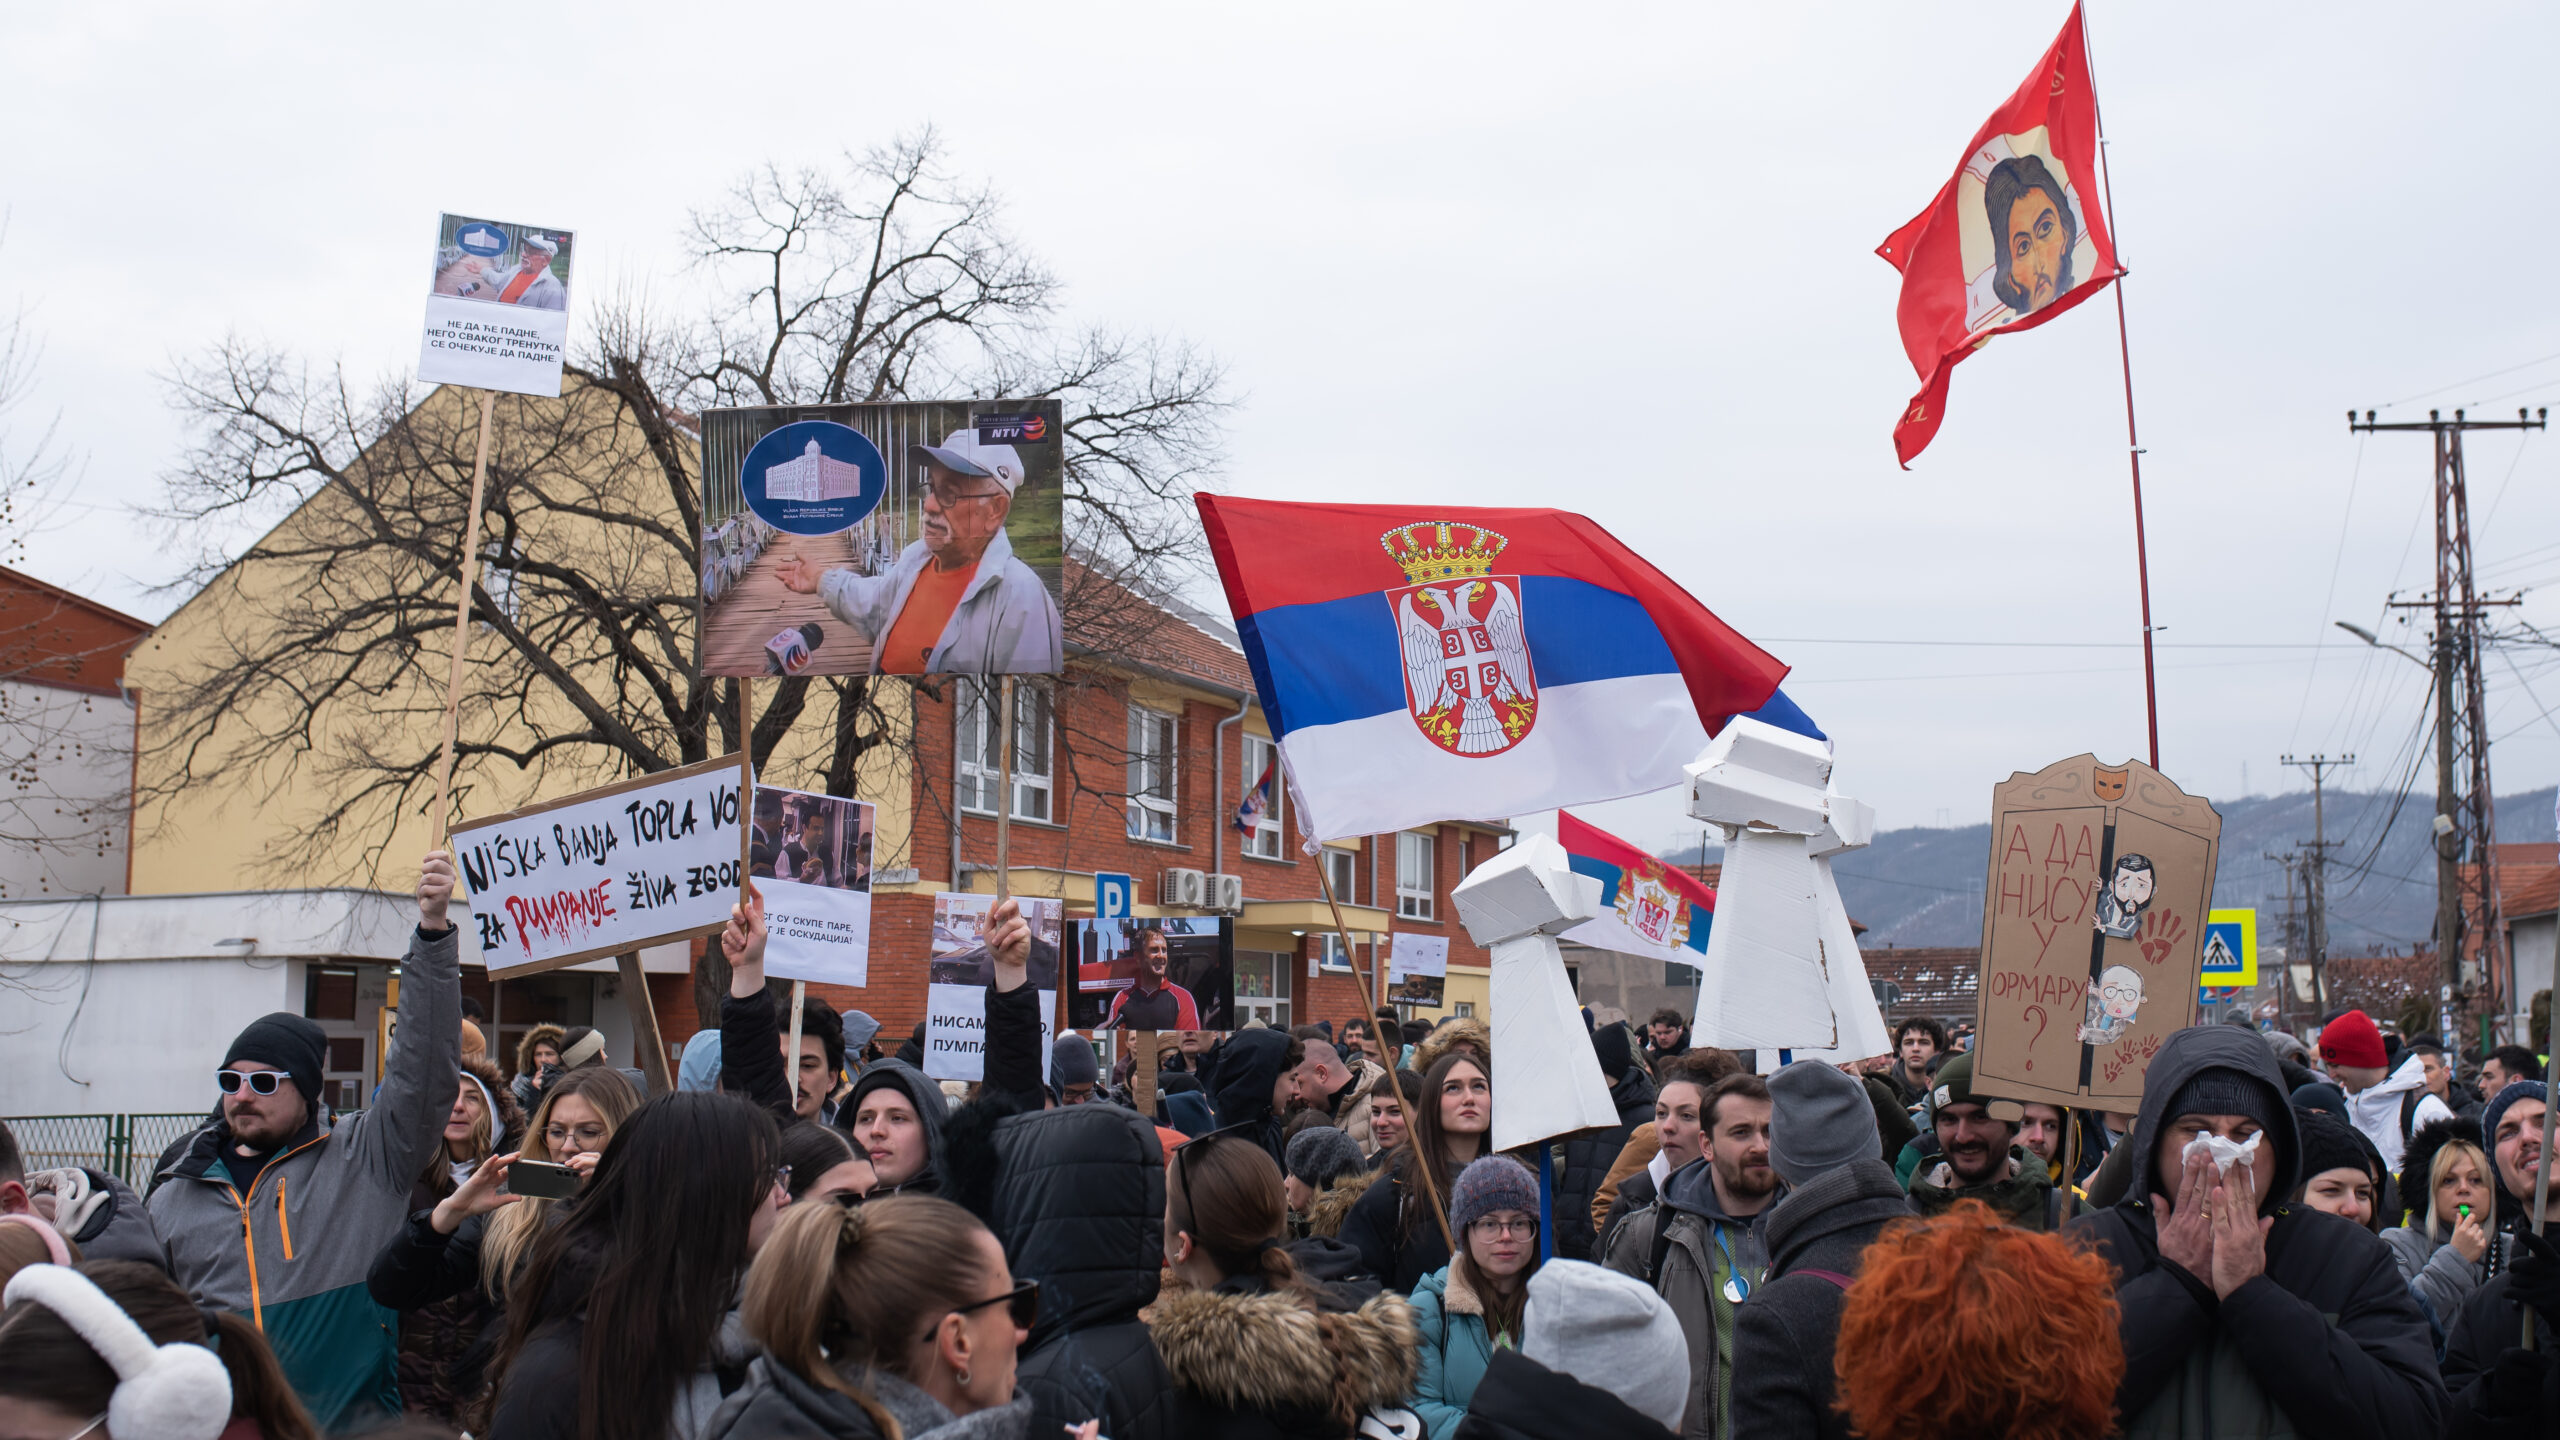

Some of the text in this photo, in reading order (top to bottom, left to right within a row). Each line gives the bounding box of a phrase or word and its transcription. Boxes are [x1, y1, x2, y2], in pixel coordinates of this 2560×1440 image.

[427, 329, 561, 352] НЕГО СВАКОГ ТРЕНУТКА
[447, 320, 540, 340] НЕ ДА ЋЕ ПАДНЕ,
[431, 340, 557, 363] СЕ ОЧЕКУЈЕ ДА ПАДНЕ.
[991, 428, 1020, 438] NTV
[625, 799, 697, 847] TOPLA
[2004, 822, 2095, 874] А ДА
[1104, 881, 1123, 918] P
[2000, 871, 2094, 926] НИСУ
[474, 912, 508, 951] ZA
[776, 914, 790, 923] СУ
[793, 916, 824, 928] СКУПЕ
[827, 921, 854, 934] ПАРЕ,
[776, 927, 786, 936] ЈЕ
[789, 928, 853, 945] ОСКУДАЦИЈА!
[2032, 921, 2058, 969] У
[1992, 971, 2086, 1012] ОРМАРУ
[2023, 1004, 2048, 1072] ?
